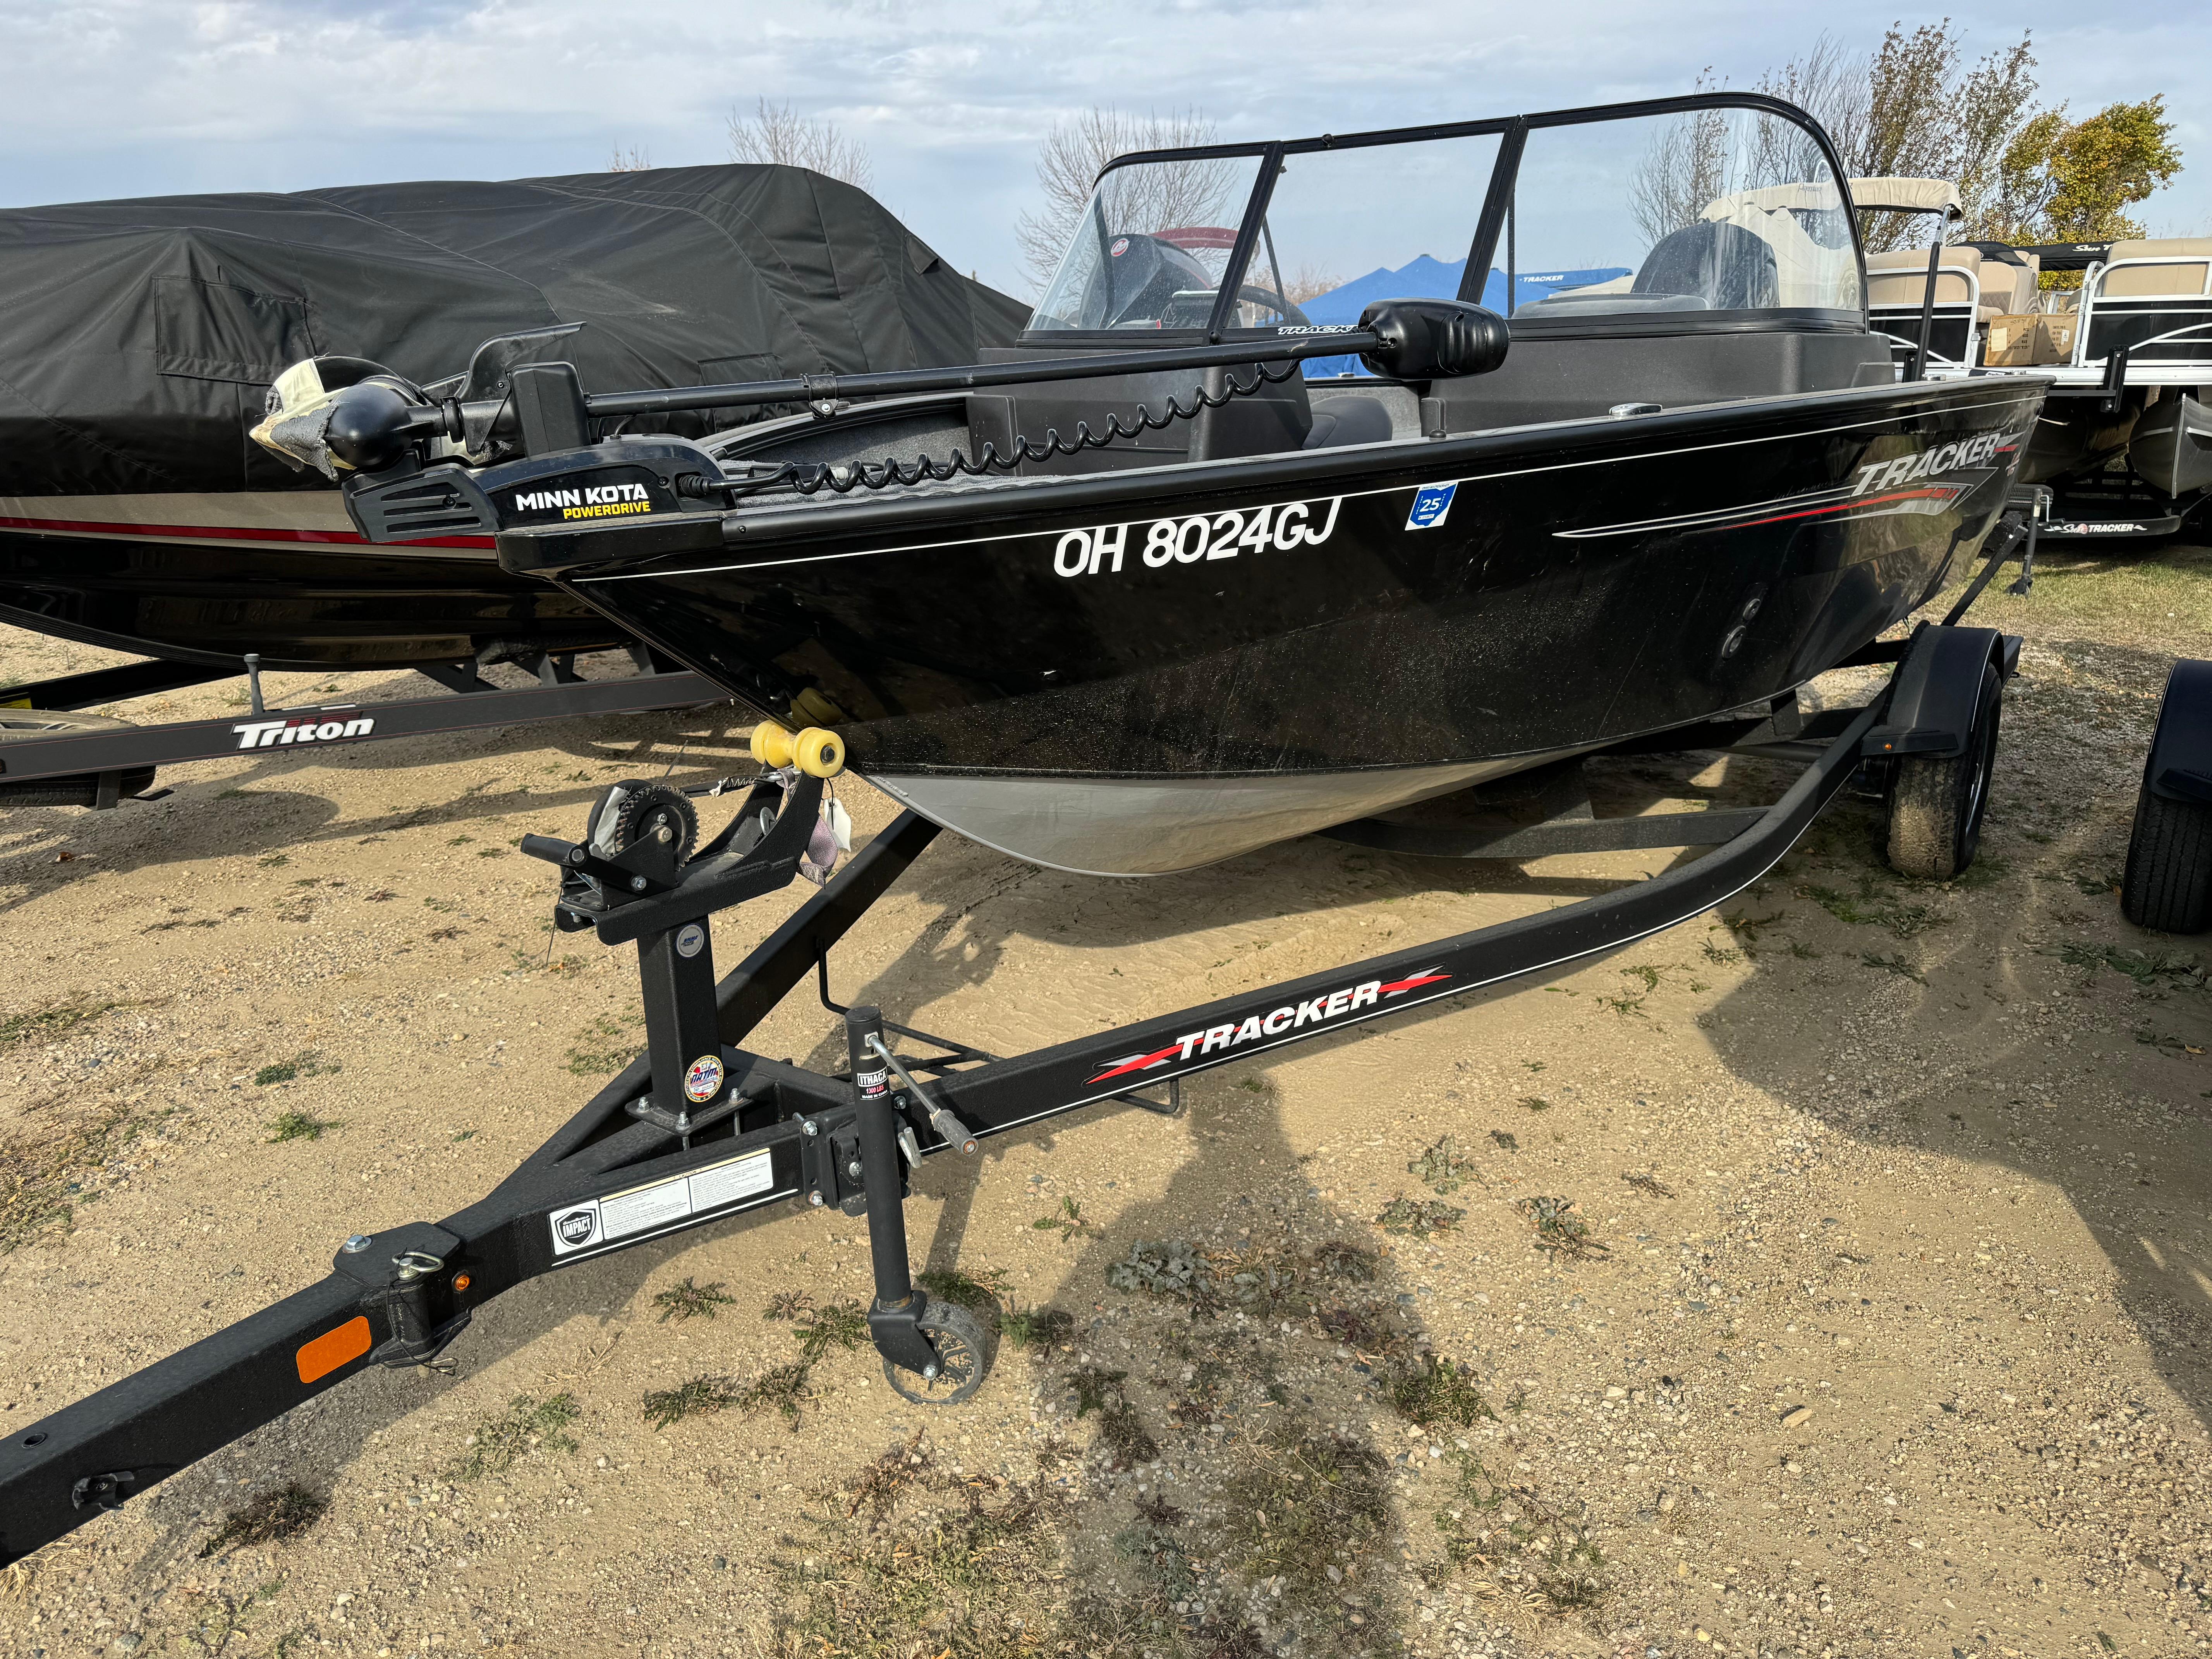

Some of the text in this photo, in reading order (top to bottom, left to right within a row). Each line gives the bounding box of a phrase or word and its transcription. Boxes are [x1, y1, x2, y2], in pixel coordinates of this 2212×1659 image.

[1278, 325, 1358, 335] TRACK
[1851, 433, 2001, 498] TRACKER
[515, 483, 649, 511] MINN KOTA
[1419, 498, 1441, 512] 25
[563, 501, 651, 519] POWERDRIVE
[1054, 496, 1342, 577] OH 8024GJ
[2088, 524, 2134, 533] TRACKER
[233, 718, 375, 749] Triton
[1175, 980, 1382, 1061] TRACKER
[690, 1067, 717, 1084] NATM
[860, 1070, 886, 1085] ITHACA
[563, 1218, 591, 1238] IMPACT
